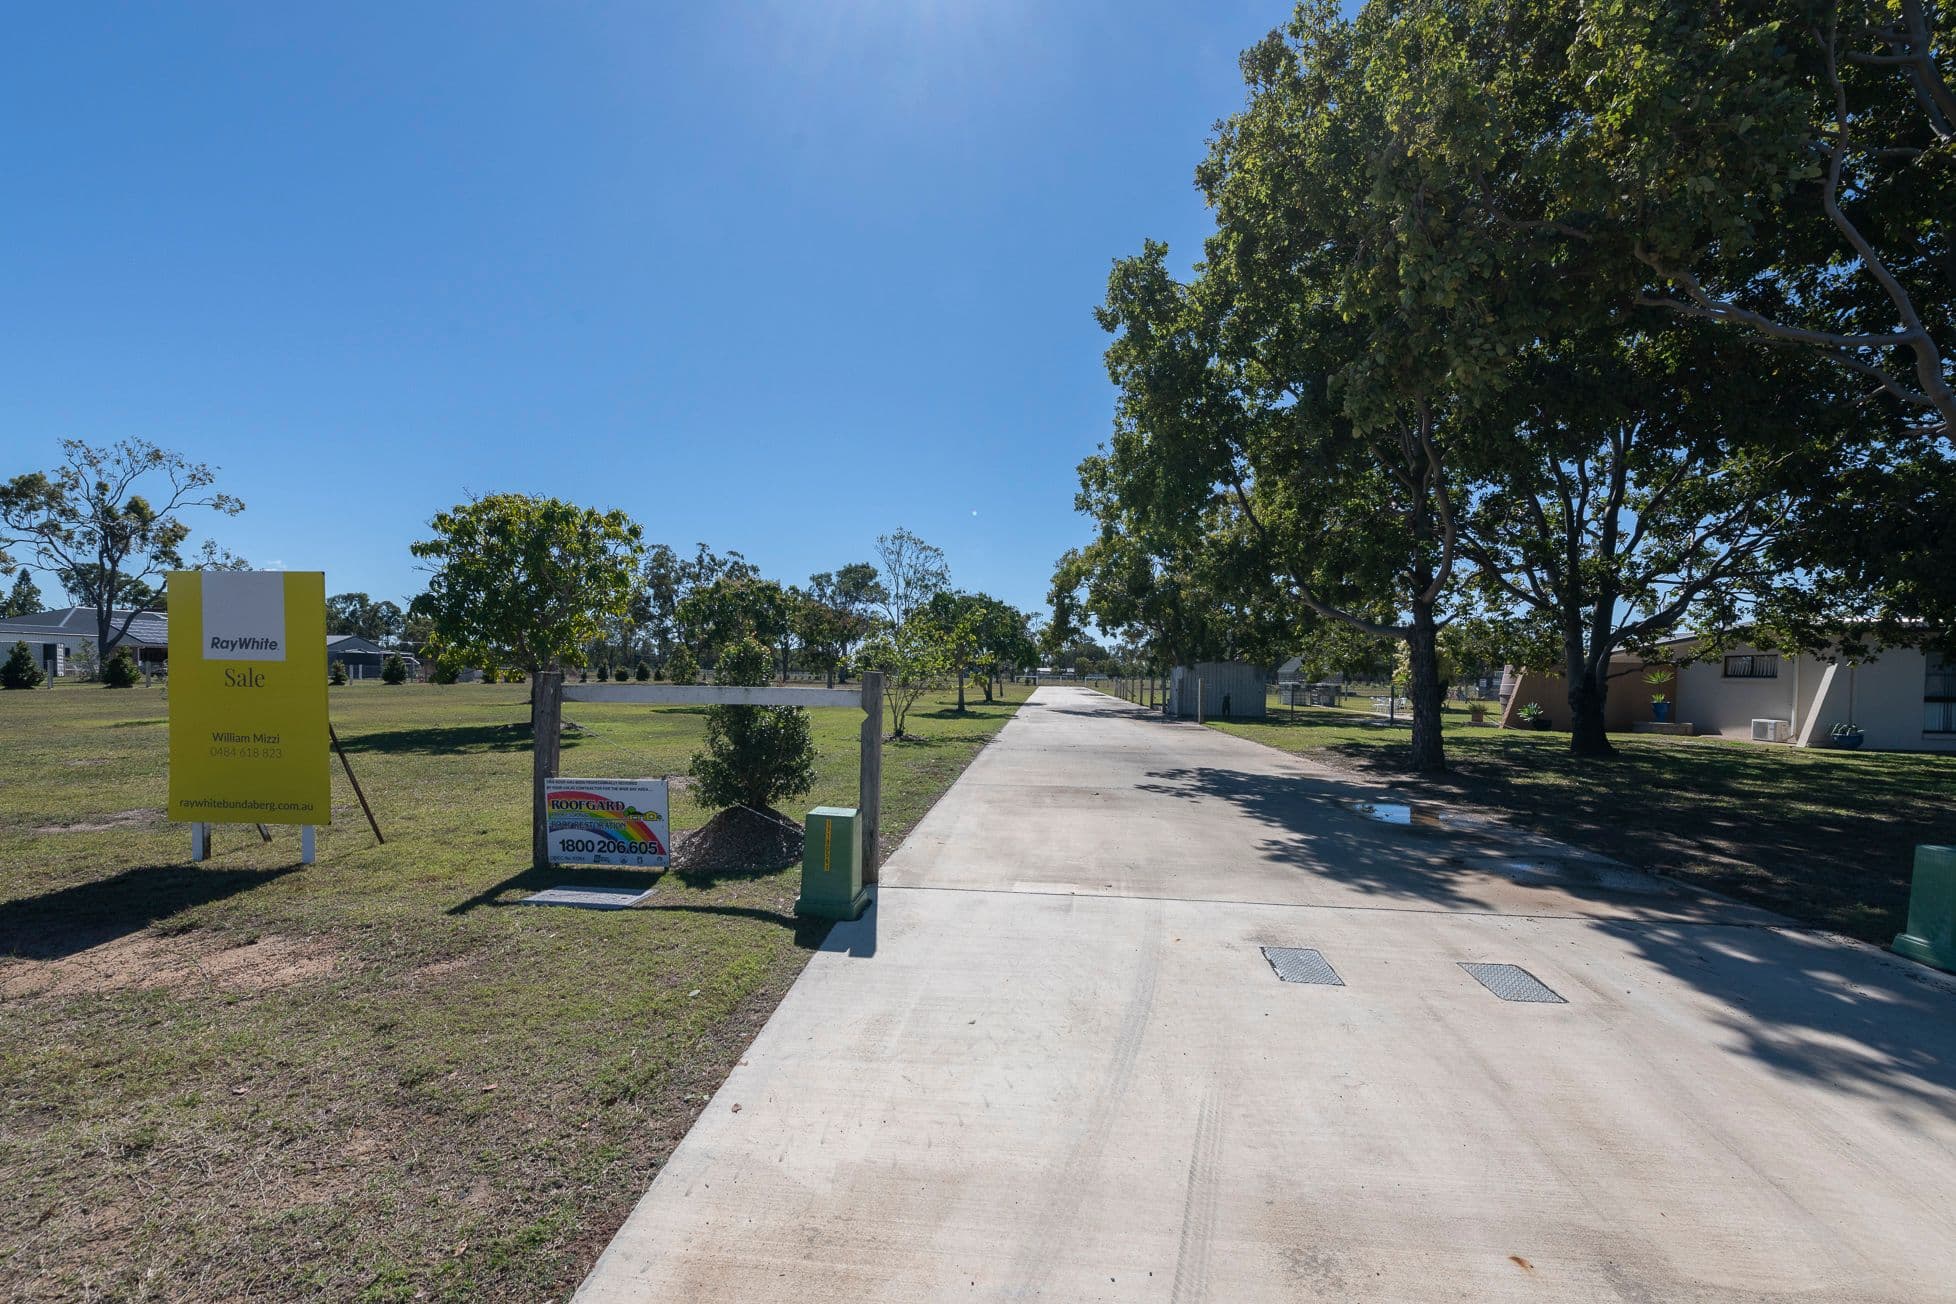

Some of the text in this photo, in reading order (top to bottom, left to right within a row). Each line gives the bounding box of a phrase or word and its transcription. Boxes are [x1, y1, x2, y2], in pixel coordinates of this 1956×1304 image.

[224, 667, 265, 688] Sale
[212, 732, 280, 744] William Mizzi
[209, 746, 282, 759] 0484 618 823
[179, 798, 314, 812] raywhitebundaberg.com.au
[552, 800, 625, 811] ROOFGARD
[559, 839, 595, 853] 1800
